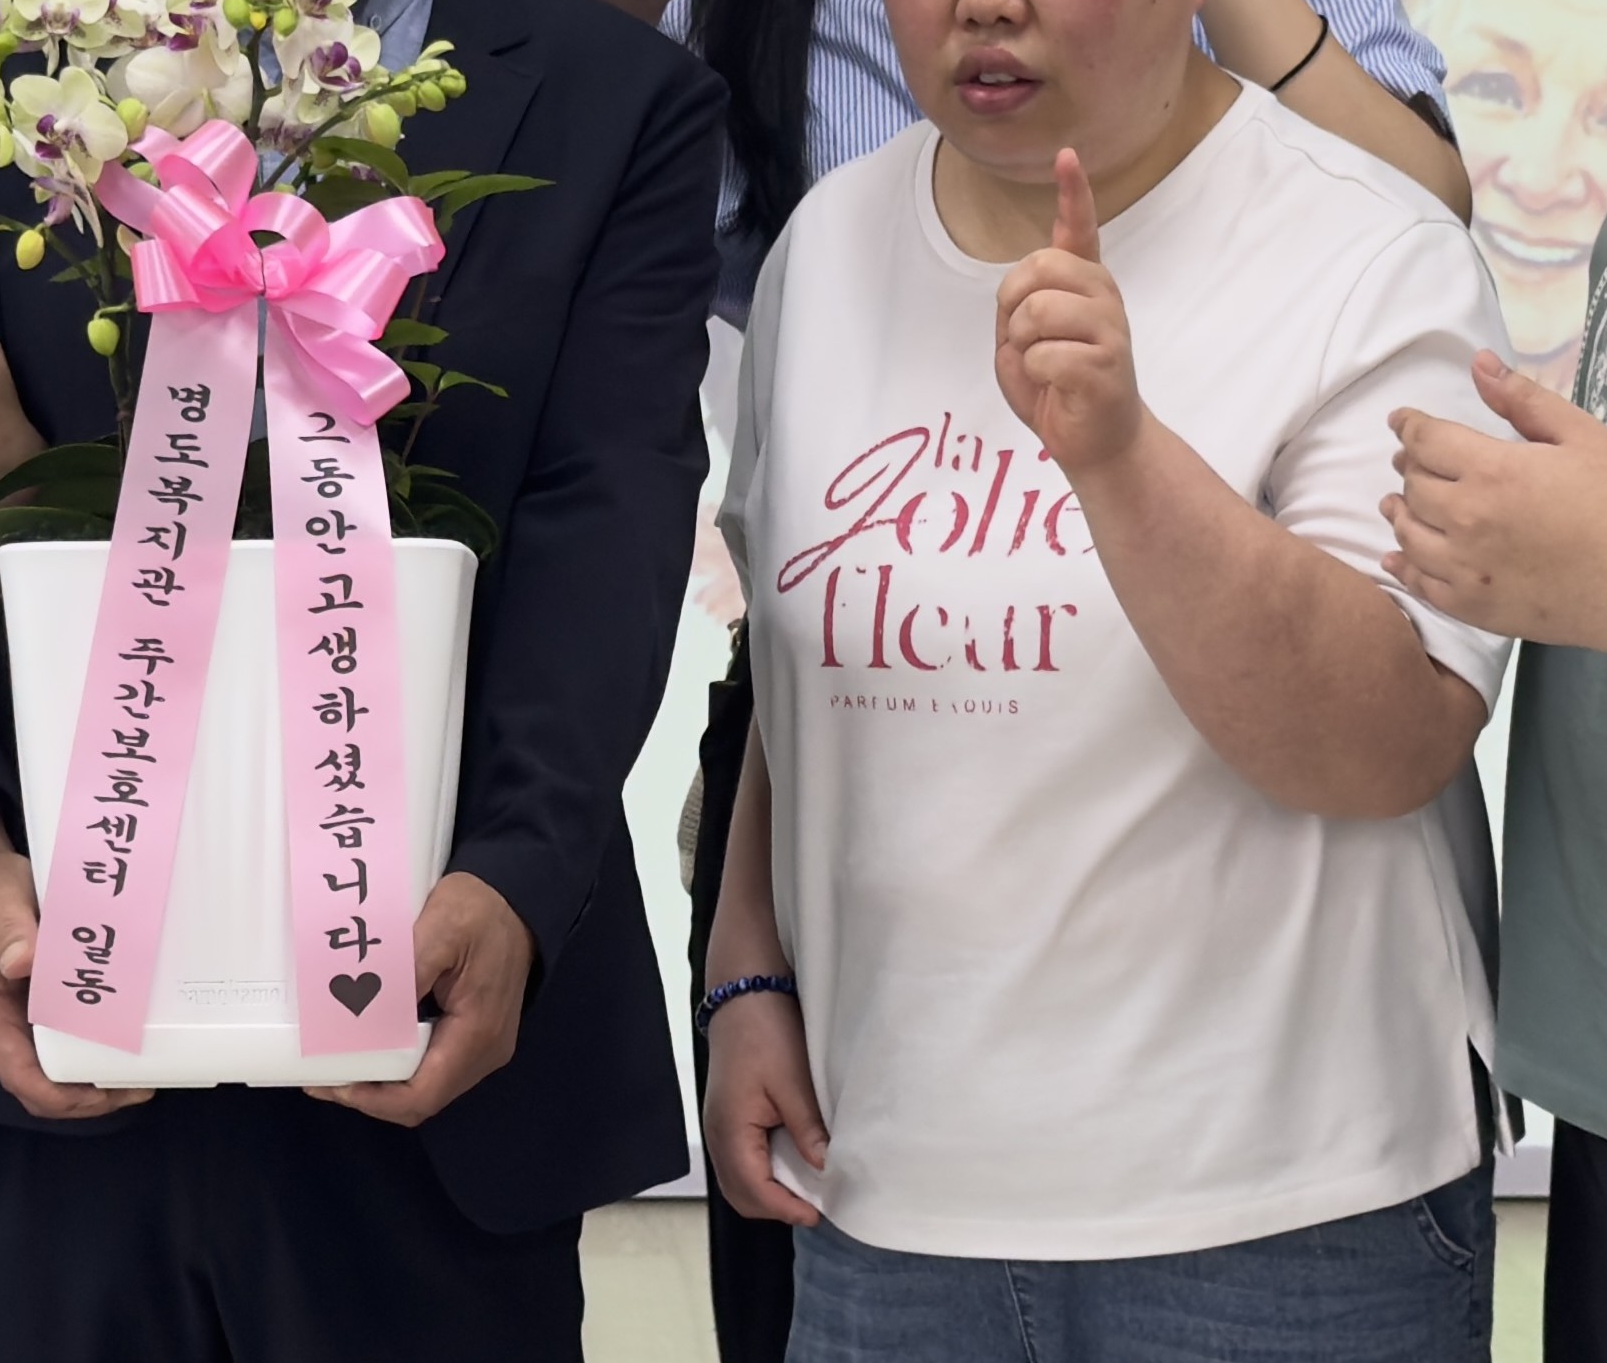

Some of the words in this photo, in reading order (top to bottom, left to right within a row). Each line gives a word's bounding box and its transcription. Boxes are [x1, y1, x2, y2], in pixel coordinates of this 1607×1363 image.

[131, 383, 211, 607] 명도복지관
[298, 411, 358, 555] 그동안
[777, 426, 1097, 593] Jolie
[82, 637, 175, 898] 주간보호센터
[308, 573, 382, 963] 고생하셨습니다
[830, 694, 916, 712] PARFUM
[61, 923, 118, 1005] 일동
